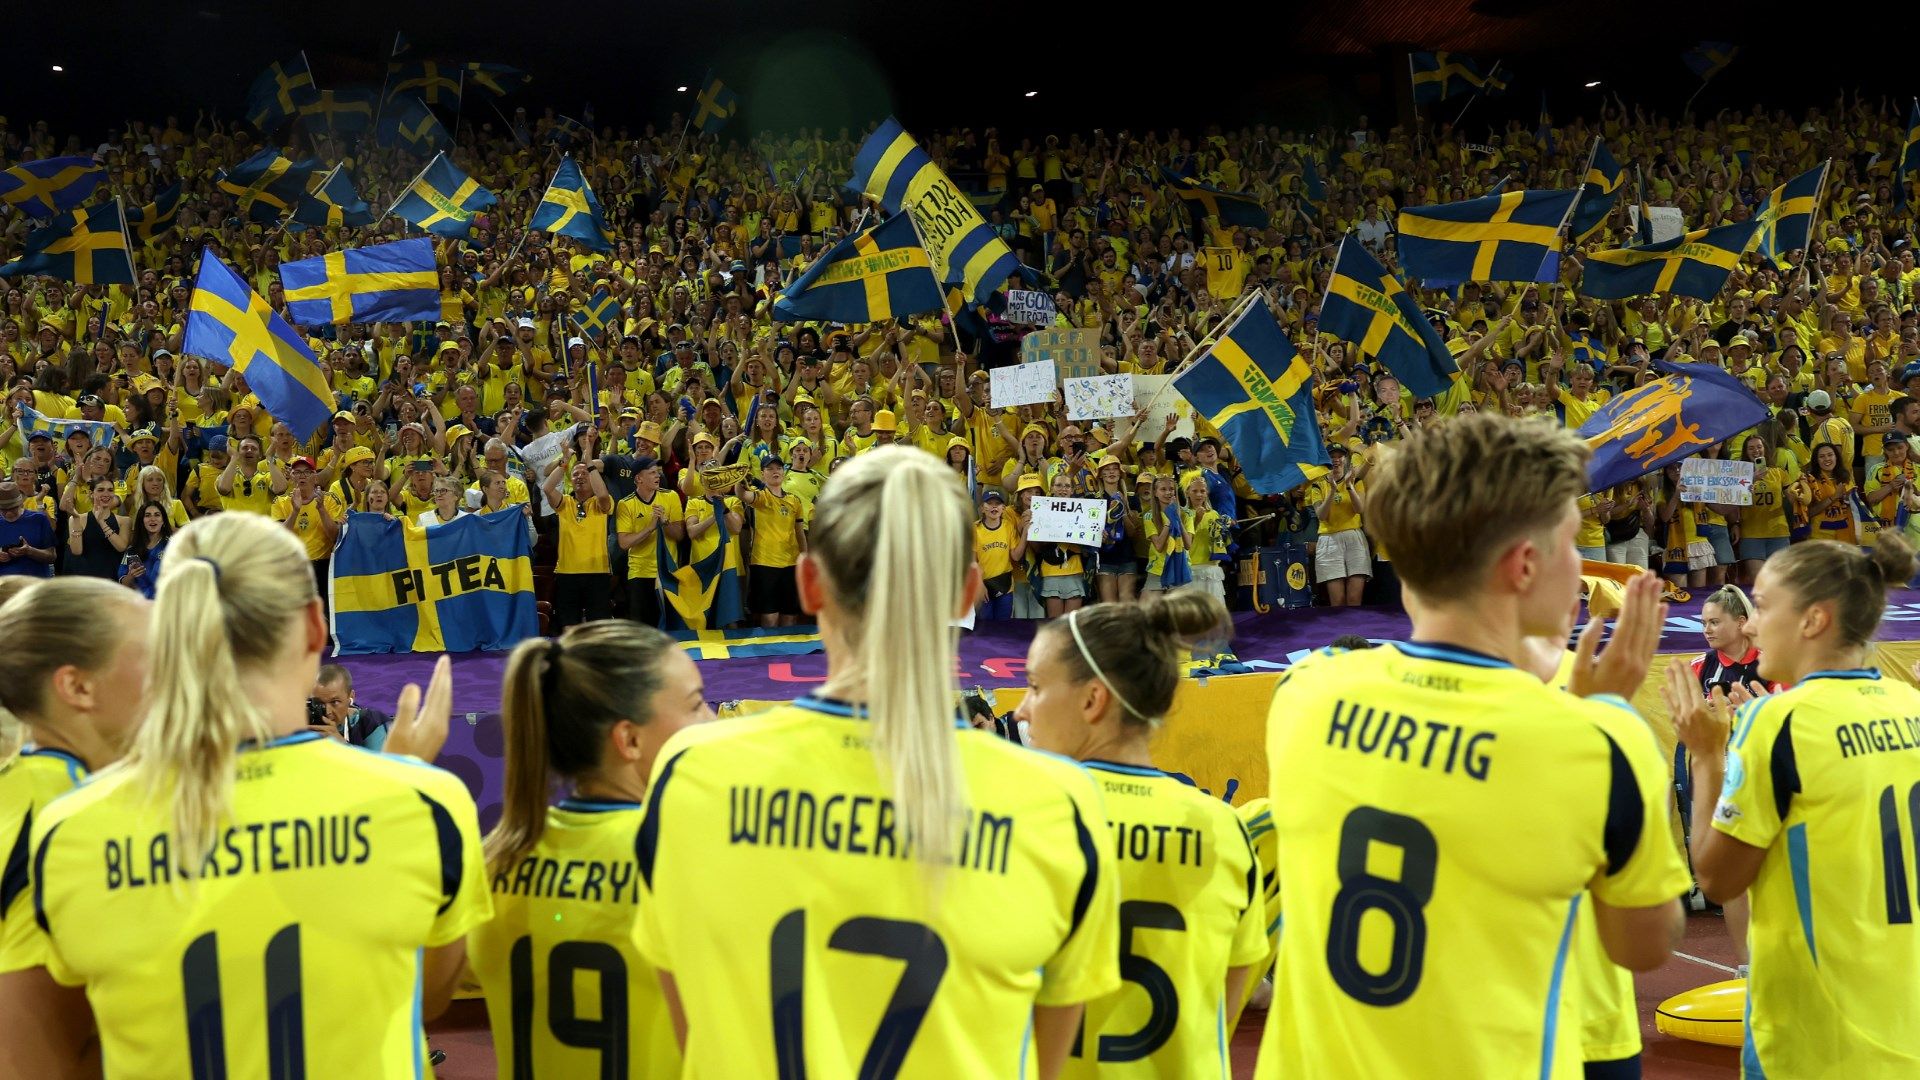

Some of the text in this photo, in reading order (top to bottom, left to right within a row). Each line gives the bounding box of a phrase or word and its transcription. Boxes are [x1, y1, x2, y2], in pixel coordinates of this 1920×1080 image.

[1217, 254, 1233, 272] 10
[1010, 302, 1025, 311] MOT
[1051, 501, 1084, 513] HEJA
[1755, 492, 1774, 506] 20
[982, 540, 1009, 553] SWEDEN
[1327, 699, 1496, 781] HURTIG
[1107, 821, 1201, 867] IOTTI
[1326, 806, 1439, 1007] 8
[181, 923, 306, 1080] 11
[510, 934, 630, 1080] 19
[768, 908, 949, 1080] 17
